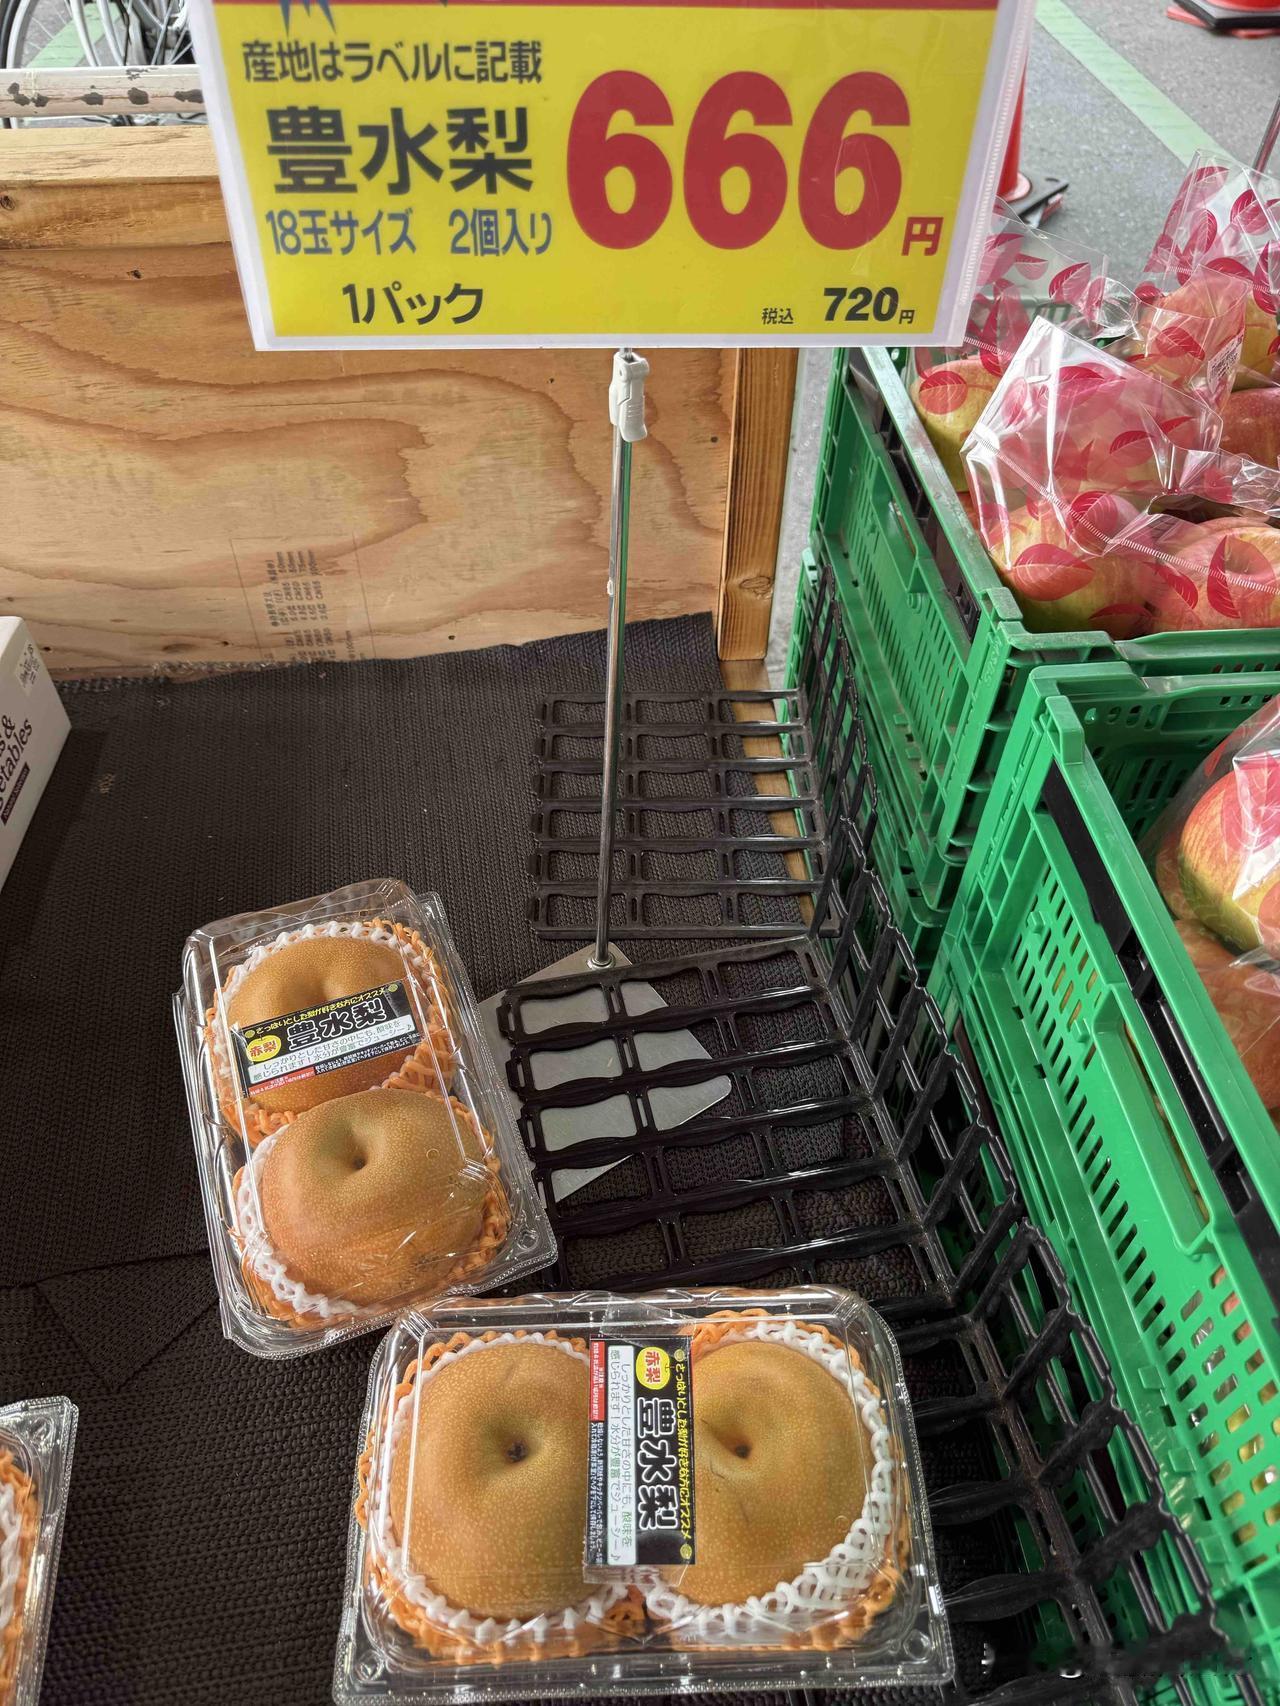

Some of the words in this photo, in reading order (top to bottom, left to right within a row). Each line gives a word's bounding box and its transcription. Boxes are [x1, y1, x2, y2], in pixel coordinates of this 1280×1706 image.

[243, 40, 542, 83] 産地はラベルに記載
[266, 105, 534, 195] 豊水梨
[266, 208, 416, 255] 18玉サイズ
[449, 208, 552, 257] 2個入り
[342, 281, 484, 325] 1パック
[762, 308, 794, 325] 税込
[286, 997, 387, 1051] 豊水梨
[250, 1040, 278, 1058] 赤梨
[645, 1350, 661, 1384] 赤梨
[621, 1363, 632, 1548] しっかりとした甘さの中にも、酸味を
[637, 1396, 679, 1530] 豊水梨
